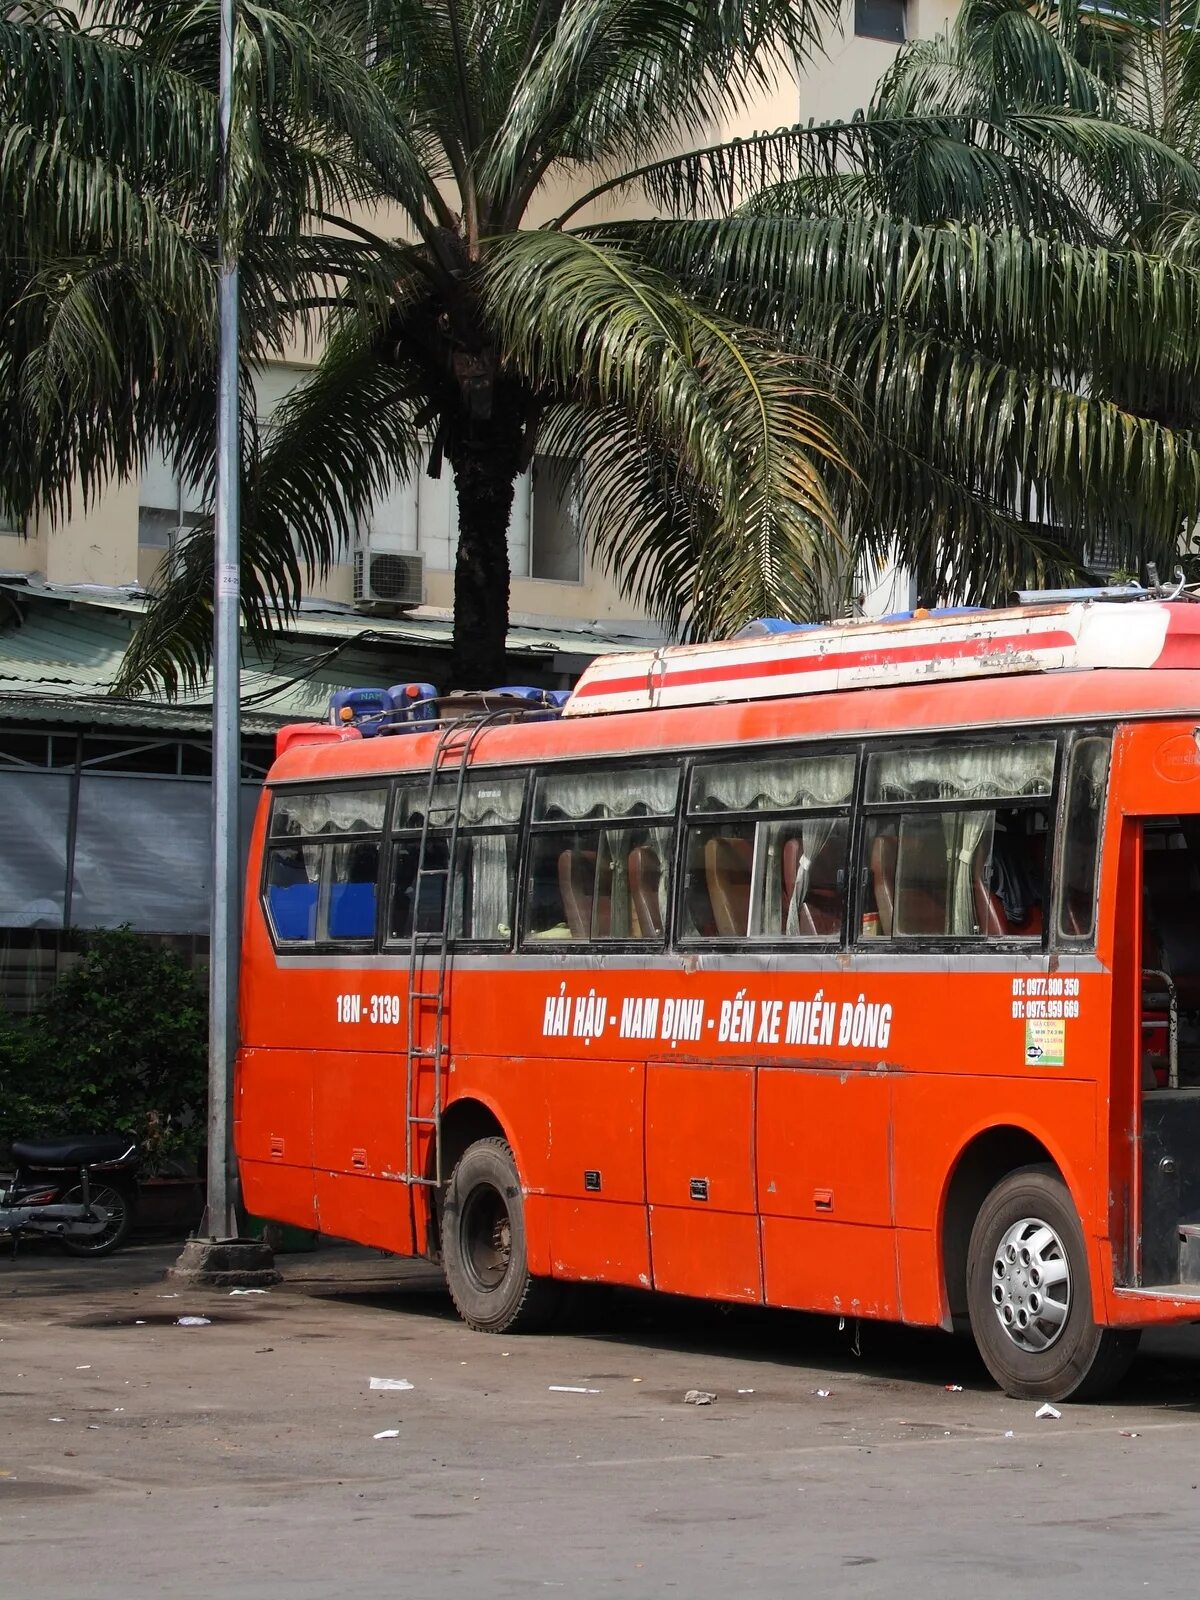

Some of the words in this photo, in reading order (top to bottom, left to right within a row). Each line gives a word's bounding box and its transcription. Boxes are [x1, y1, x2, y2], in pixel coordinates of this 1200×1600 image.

[1063, 977, 1080, 996] 350
[336, 994, 361, 1023] 18N
[370, 994, 400, 1024] 3139
[542, 981, 572, 1036] HẢI
[572, 988, 607, 1046] HẬU
[609, 1016, 617, 1025] -
[619, 997, 659, 1039] NAM
[661, 998, 705, 1049] ĐỊNH
[707, 1019, 715, 1029] -
[718, 988, 756, 1043] BẾN
[757, 1000, 783, 1044] XE
[785, 988, 837, 1046] MIỀN
[838, 993, 893, 1048] ĐÔNG
[1063, 1000, 1079, 1018] 669
